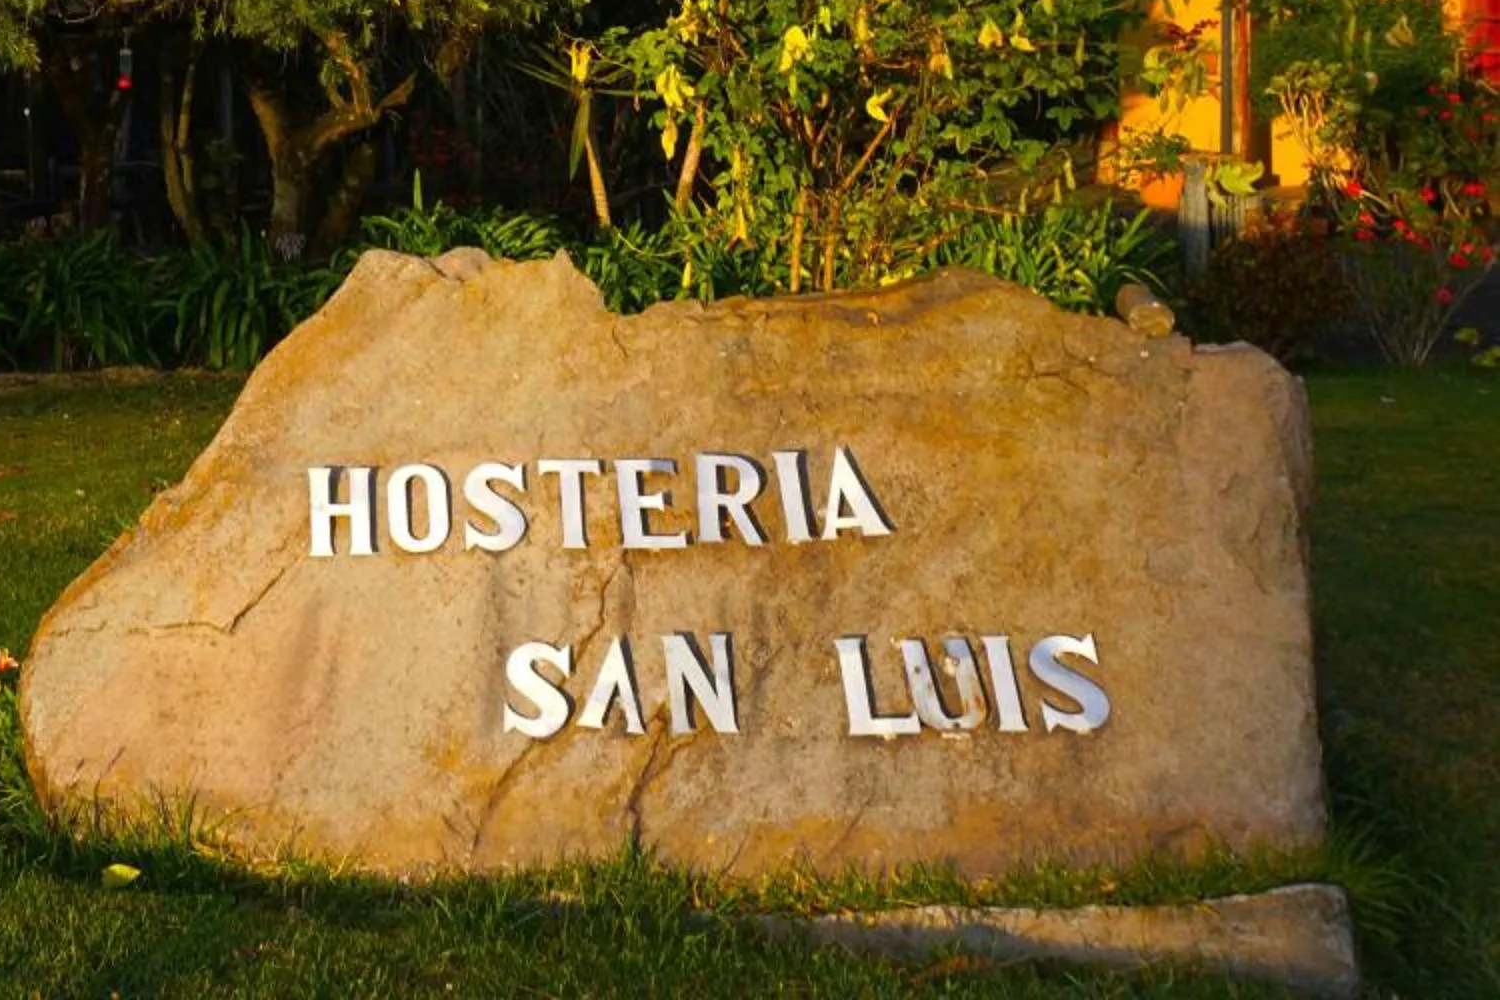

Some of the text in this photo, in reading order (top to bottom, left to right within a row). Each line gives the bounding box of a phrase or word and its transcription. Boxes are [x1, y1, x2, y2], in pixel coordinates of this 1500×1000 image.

[306, 446, 893, 557] HOSTERIA
[502, 630, 1112, 741] SAN LUIS
